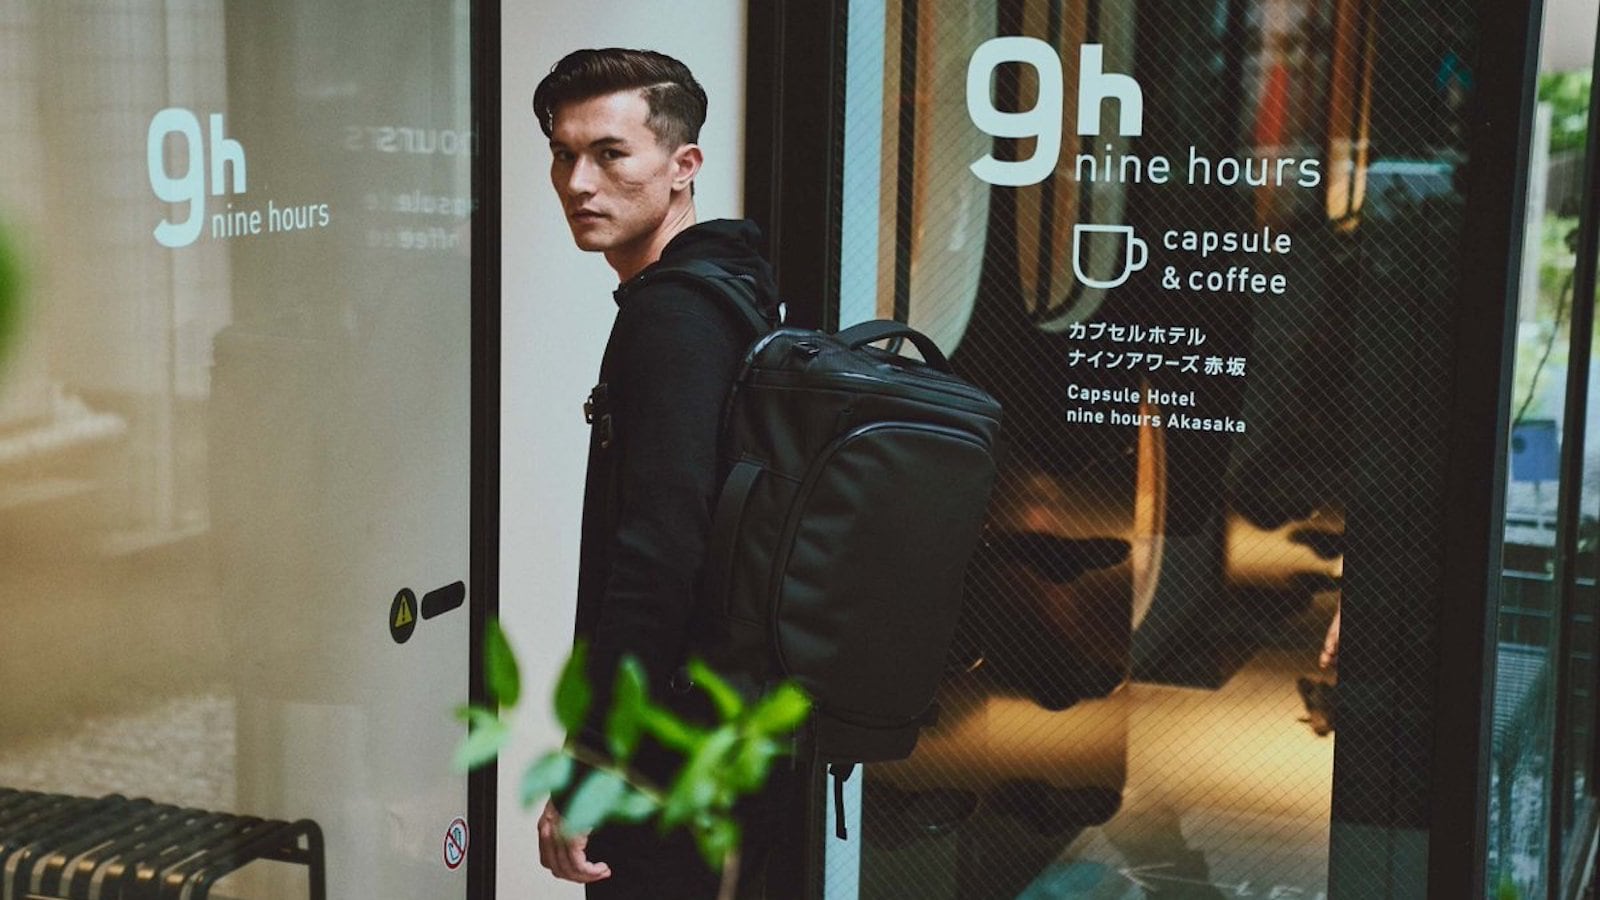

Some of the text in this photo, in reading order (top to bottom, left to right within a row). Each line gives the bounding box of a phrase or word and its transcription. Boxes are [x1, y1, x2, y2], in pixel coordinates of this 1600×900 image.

[966, 36, 1143, 187] 9h
[147, 107, 247, 248] 9h
[1075, 144, 1322, 188] nine hours
[212, 200, 330, 238] nine hours
[1163, 226, 1292, 258] capsule
[1162, 265, 1288, 294] & coffee
[1068, 321, 1207, 346] カプセルホテル
[1067, 384, 1196, 407] Capsule Hotel
[1067, 407, 1246, 433] nine hours Akasaka
